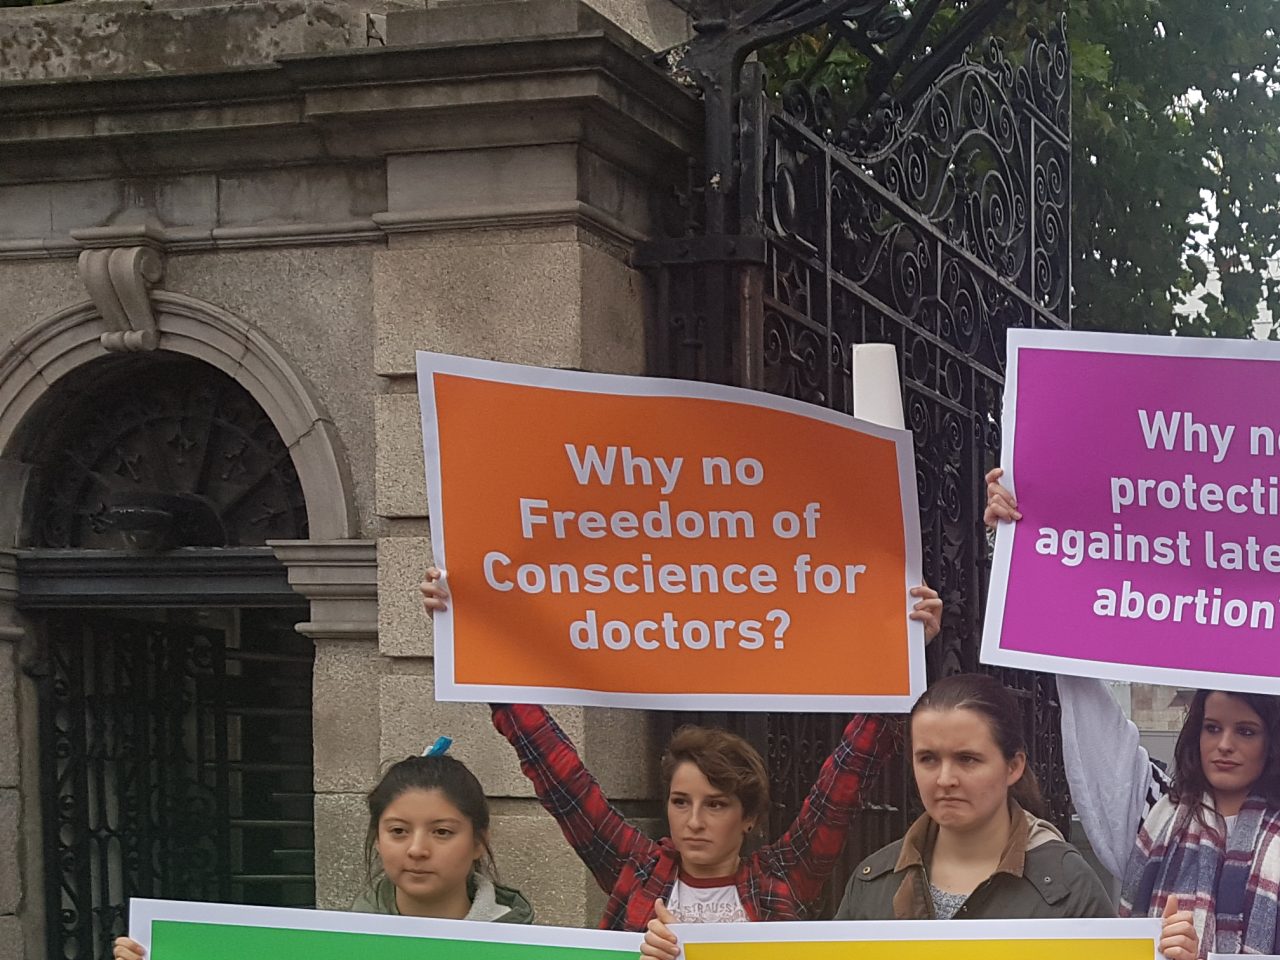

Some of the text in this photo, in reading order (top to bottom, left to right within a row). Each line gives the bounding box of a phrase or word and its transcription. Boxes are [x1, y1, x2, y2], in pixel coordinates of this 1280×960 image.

[1138, 409, 1233, 463] Why
[564, 443, 764, 495] Why no
[519, 497, 821, 539] Freedom of
[1035, 526, 1192, 567] against
[483, 551, 867, 594] Conscience for
[569, 608, 791, 651] doctors?
